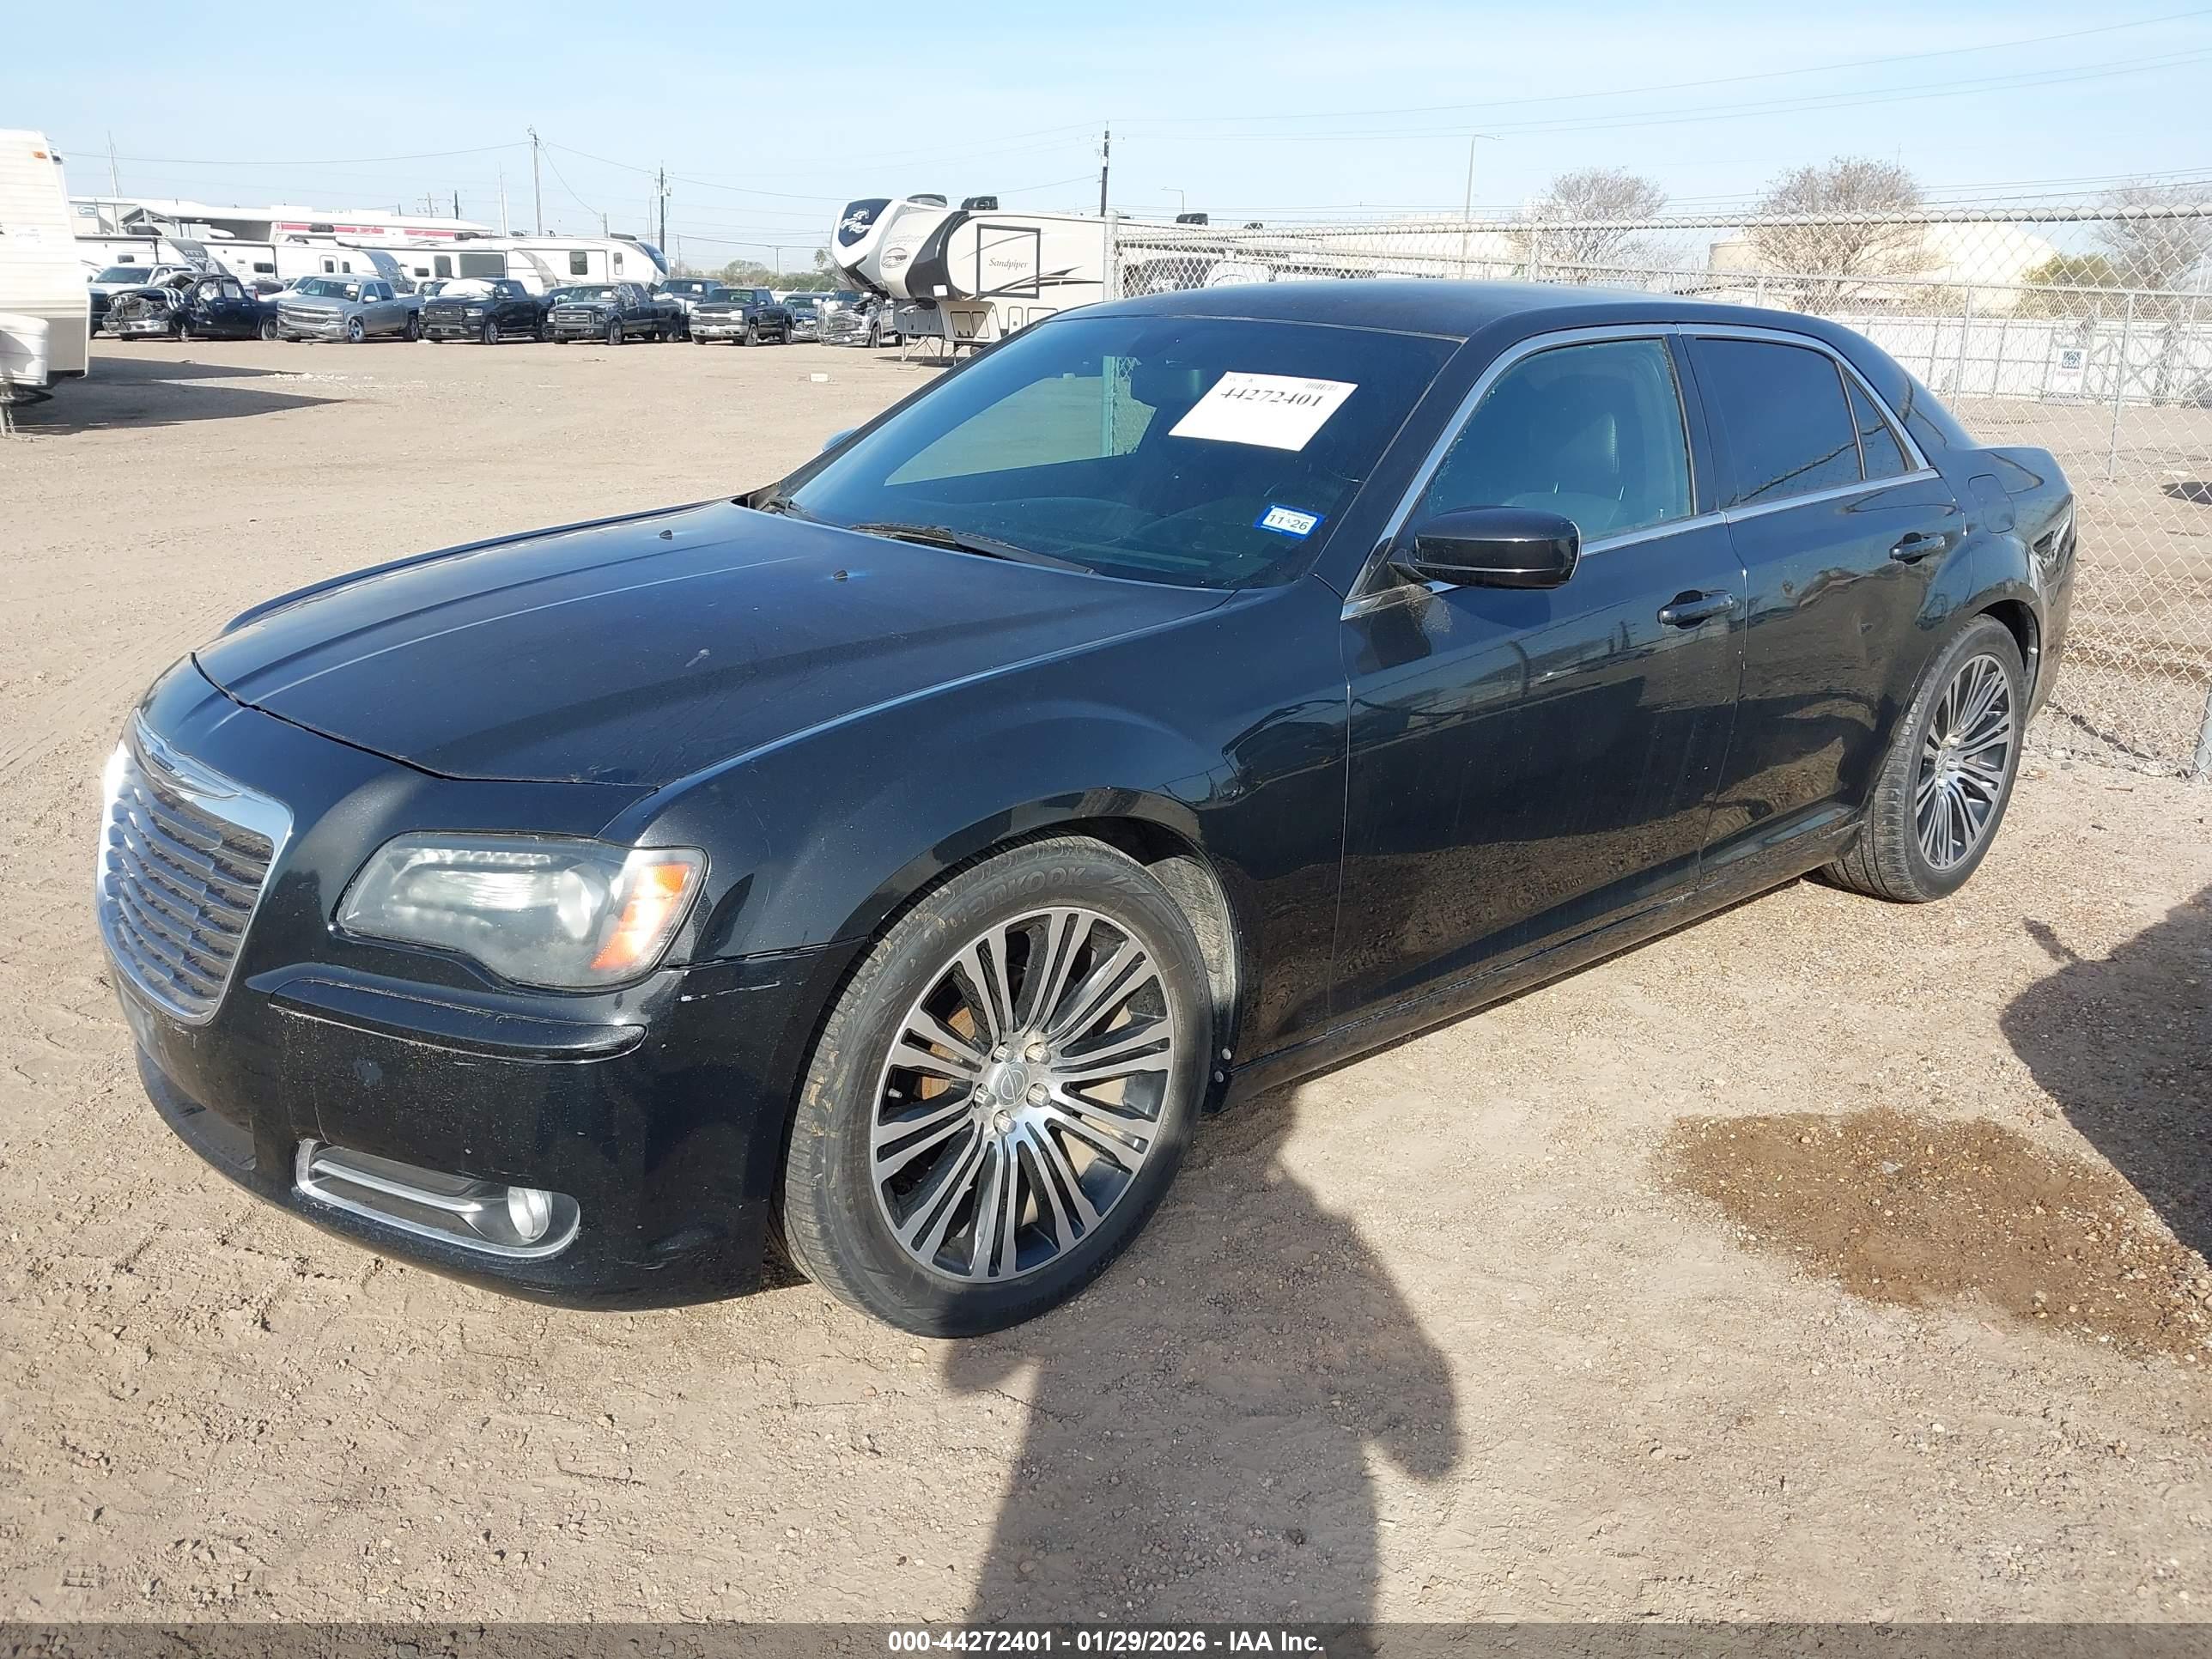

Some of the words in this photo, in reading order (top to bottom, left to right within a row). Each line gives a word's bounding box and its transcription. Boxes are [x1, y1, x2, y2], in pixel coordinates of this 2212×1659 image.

[988, 258, 1030, 270] Sandpiper
[1221, 387, 1324, 407] 44272401
[1269, 514, 1285, 525] 11
[1290, 519, 1310, 531] 26
